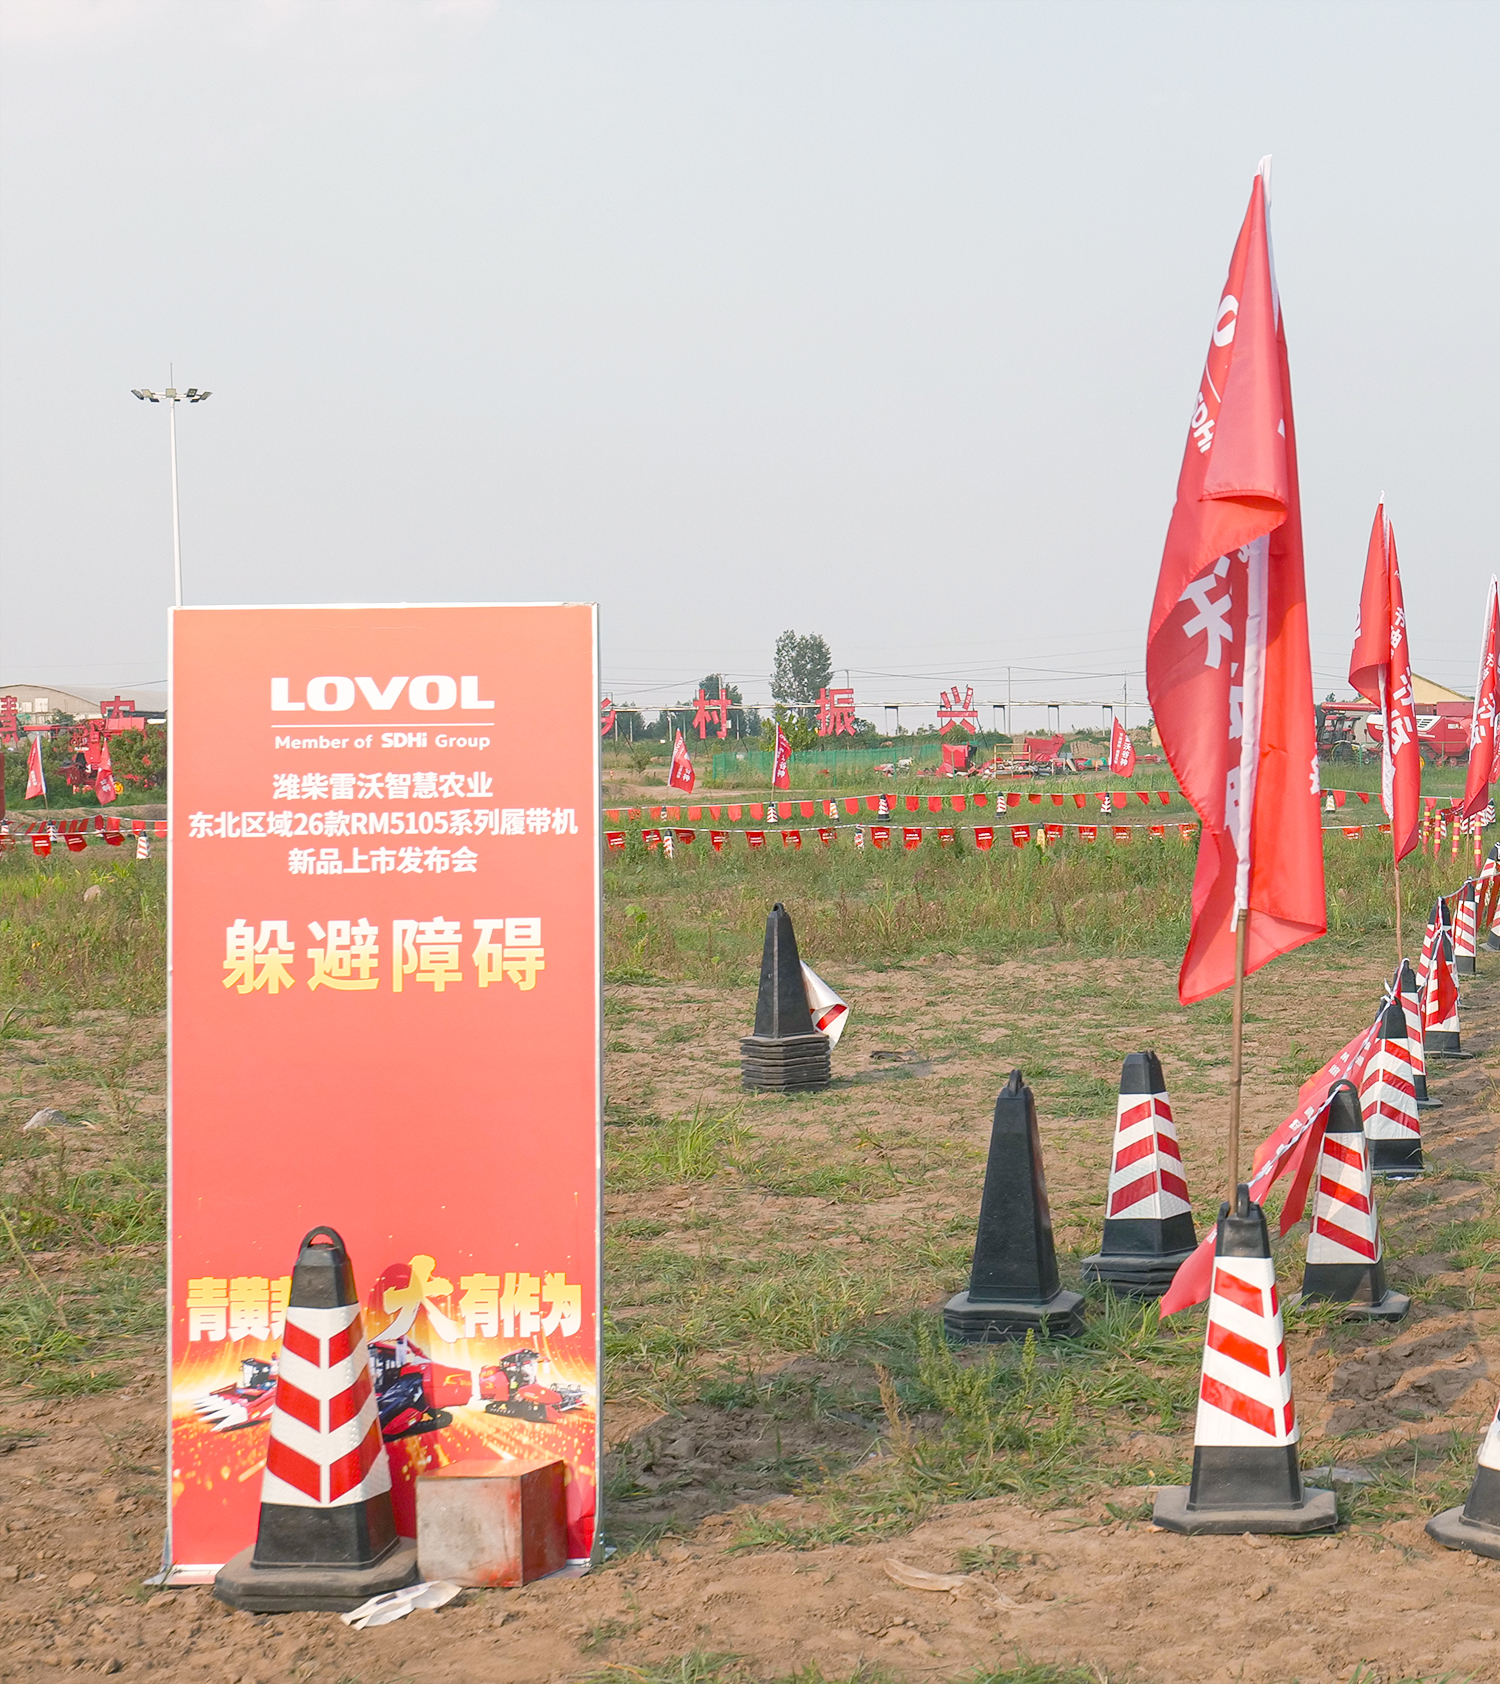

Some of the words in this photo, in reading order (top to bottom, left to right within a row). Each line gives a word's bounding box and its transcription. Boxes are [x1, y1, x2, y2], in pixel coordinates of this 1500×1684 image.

[271, 675, 495, 712] LOVOL
[275, 735, 350, 751] Member
[354, 735, 373, 751] of
[381, 732, 428, 749] SDHi
[435, 735, 492, 753] Group
[273, 771, 494, 801] 潍柴雷沃智慧农业
[188, 808, 579, 839] 东北区域26款RM5105系列履带机
[288, 846, 479, 876] 新品上市发布会
[222, 916, 547, 996] 躲避障碍
[366, 1254, 582, 1343] 大有作为
